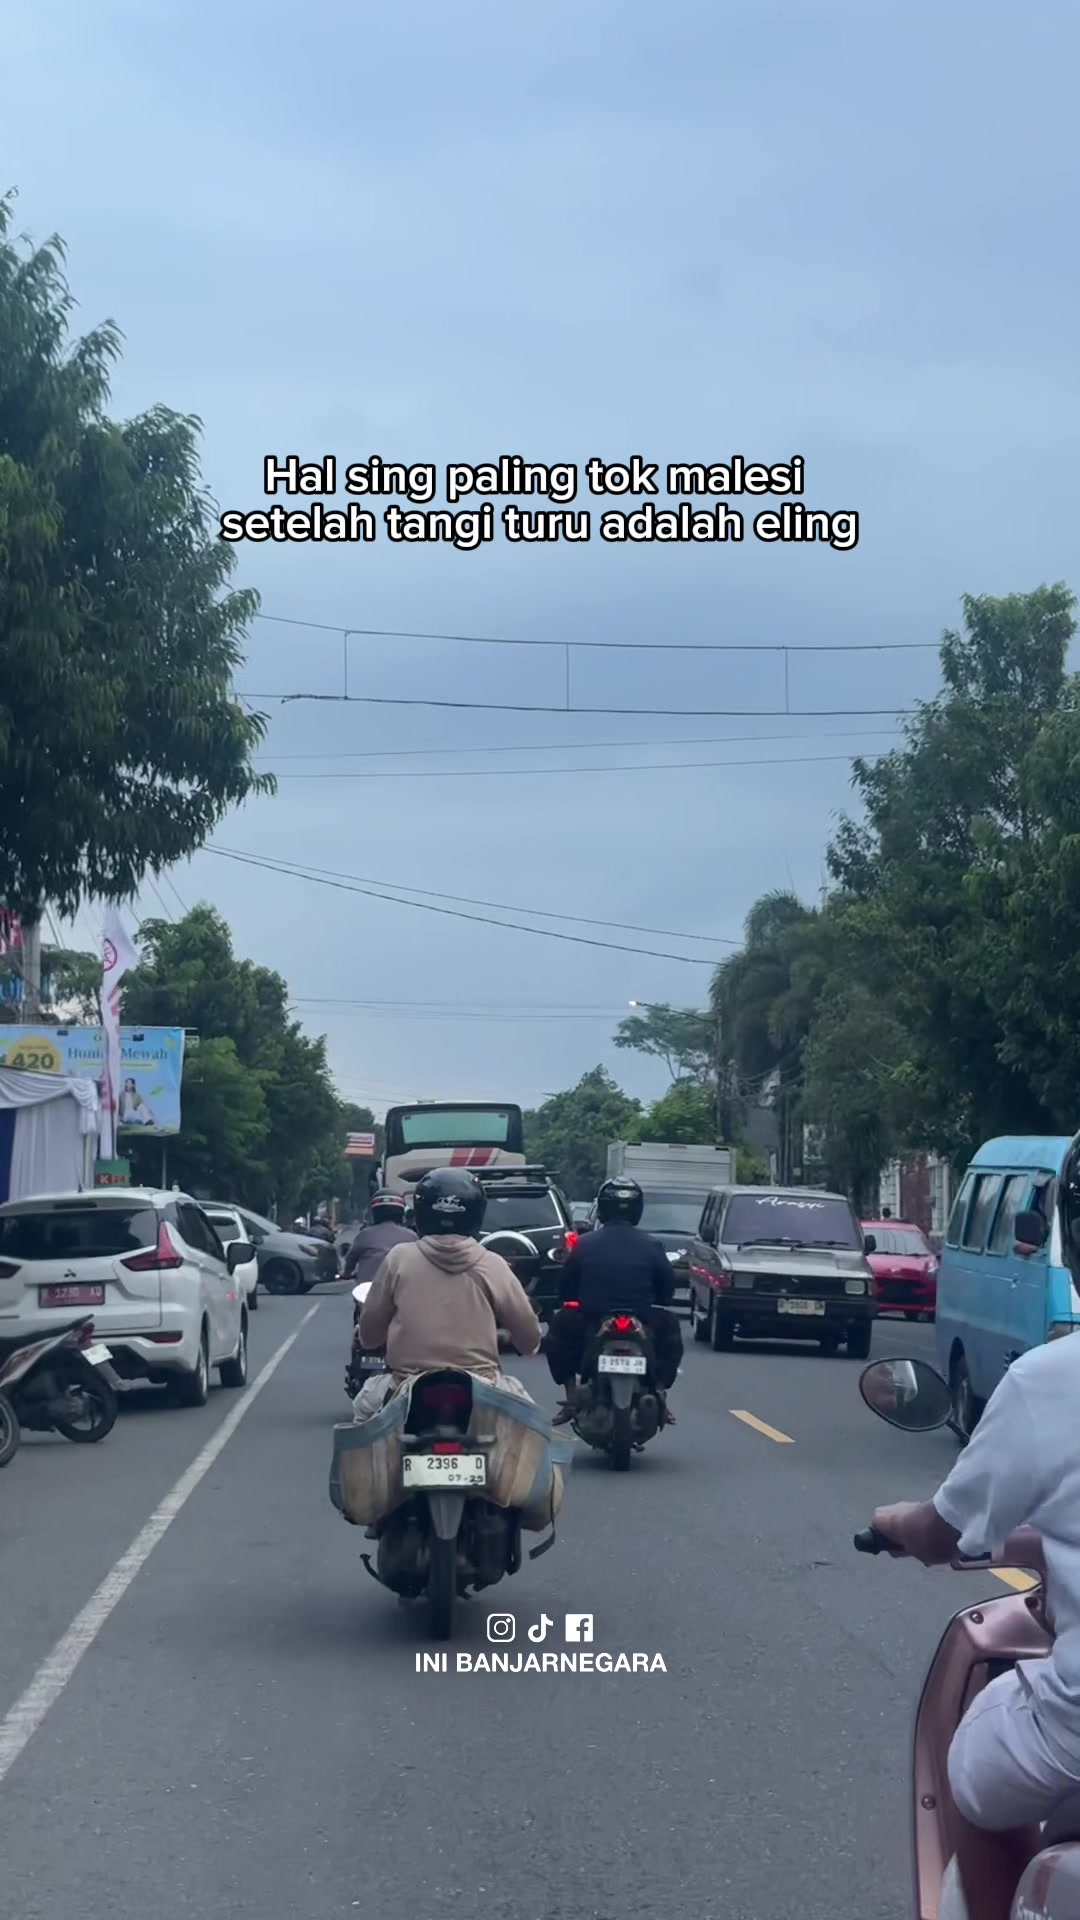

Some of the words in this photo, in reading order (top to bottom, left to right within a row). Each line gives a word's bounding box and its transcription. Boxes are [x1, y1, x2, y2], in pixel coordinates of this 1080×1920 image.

[12, 1052, 54, 1069] 420
[120, 1047, 168, 1060] Mewah
[404, 1458, 412, 1471] R
[427, 1457, 458, 1470] 2396
[476, 1457, 483, 1470] D
